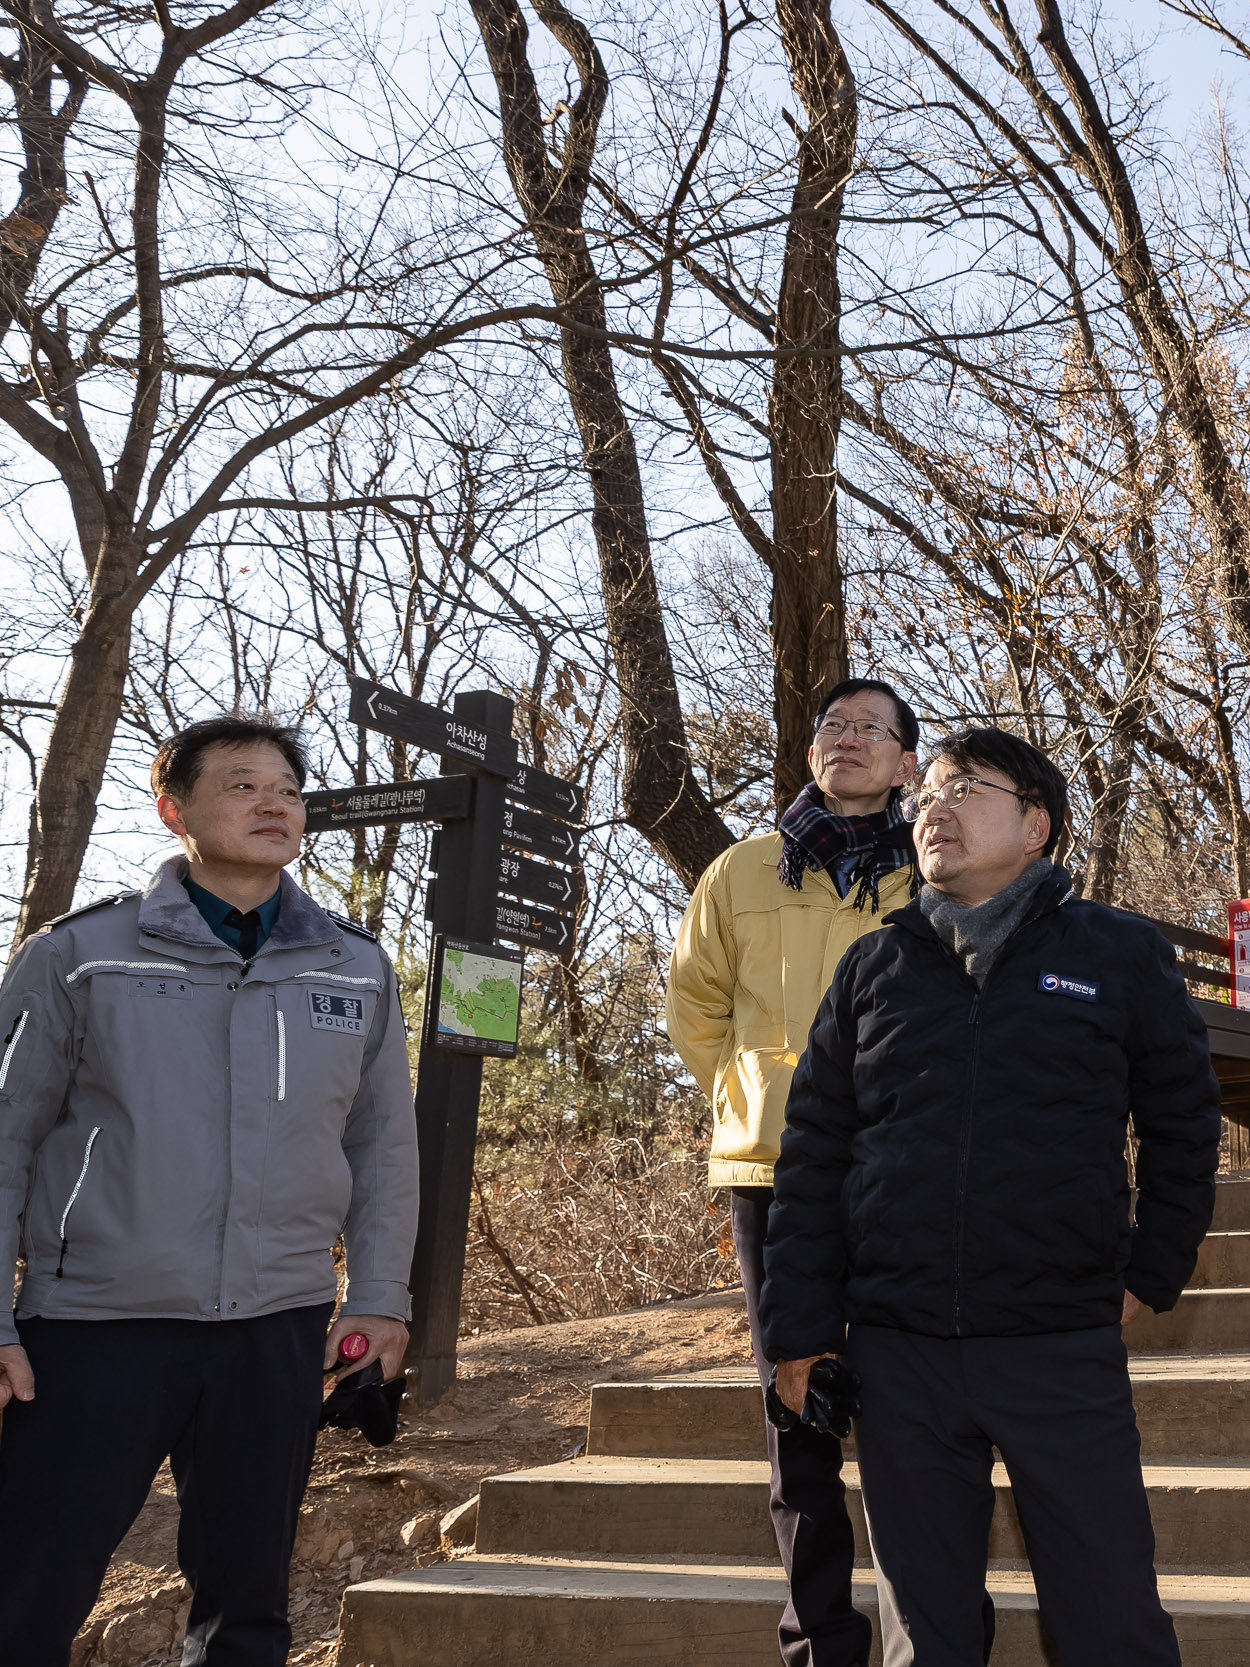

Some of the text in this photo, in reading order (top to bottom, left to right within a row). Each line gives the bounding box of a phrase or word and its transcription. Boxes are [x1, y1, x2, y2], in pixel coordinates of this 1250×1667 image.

[378, 702, 398, 716] 0.37km
[446, 722, 488, 751] 아차산성
[446, 739, 486, 761] Achasanseong
[346, 788, 426, 811] 서울둘레길(광나루역)
[331, 812, 349, 821] Seoul
[399, 804, 425, 814] Station)
[1060, 979, 1096, 996] 행정안전부
[315, 994, 359, 1018] 경찰
[316, 1015, 361, 1031] POLICE
